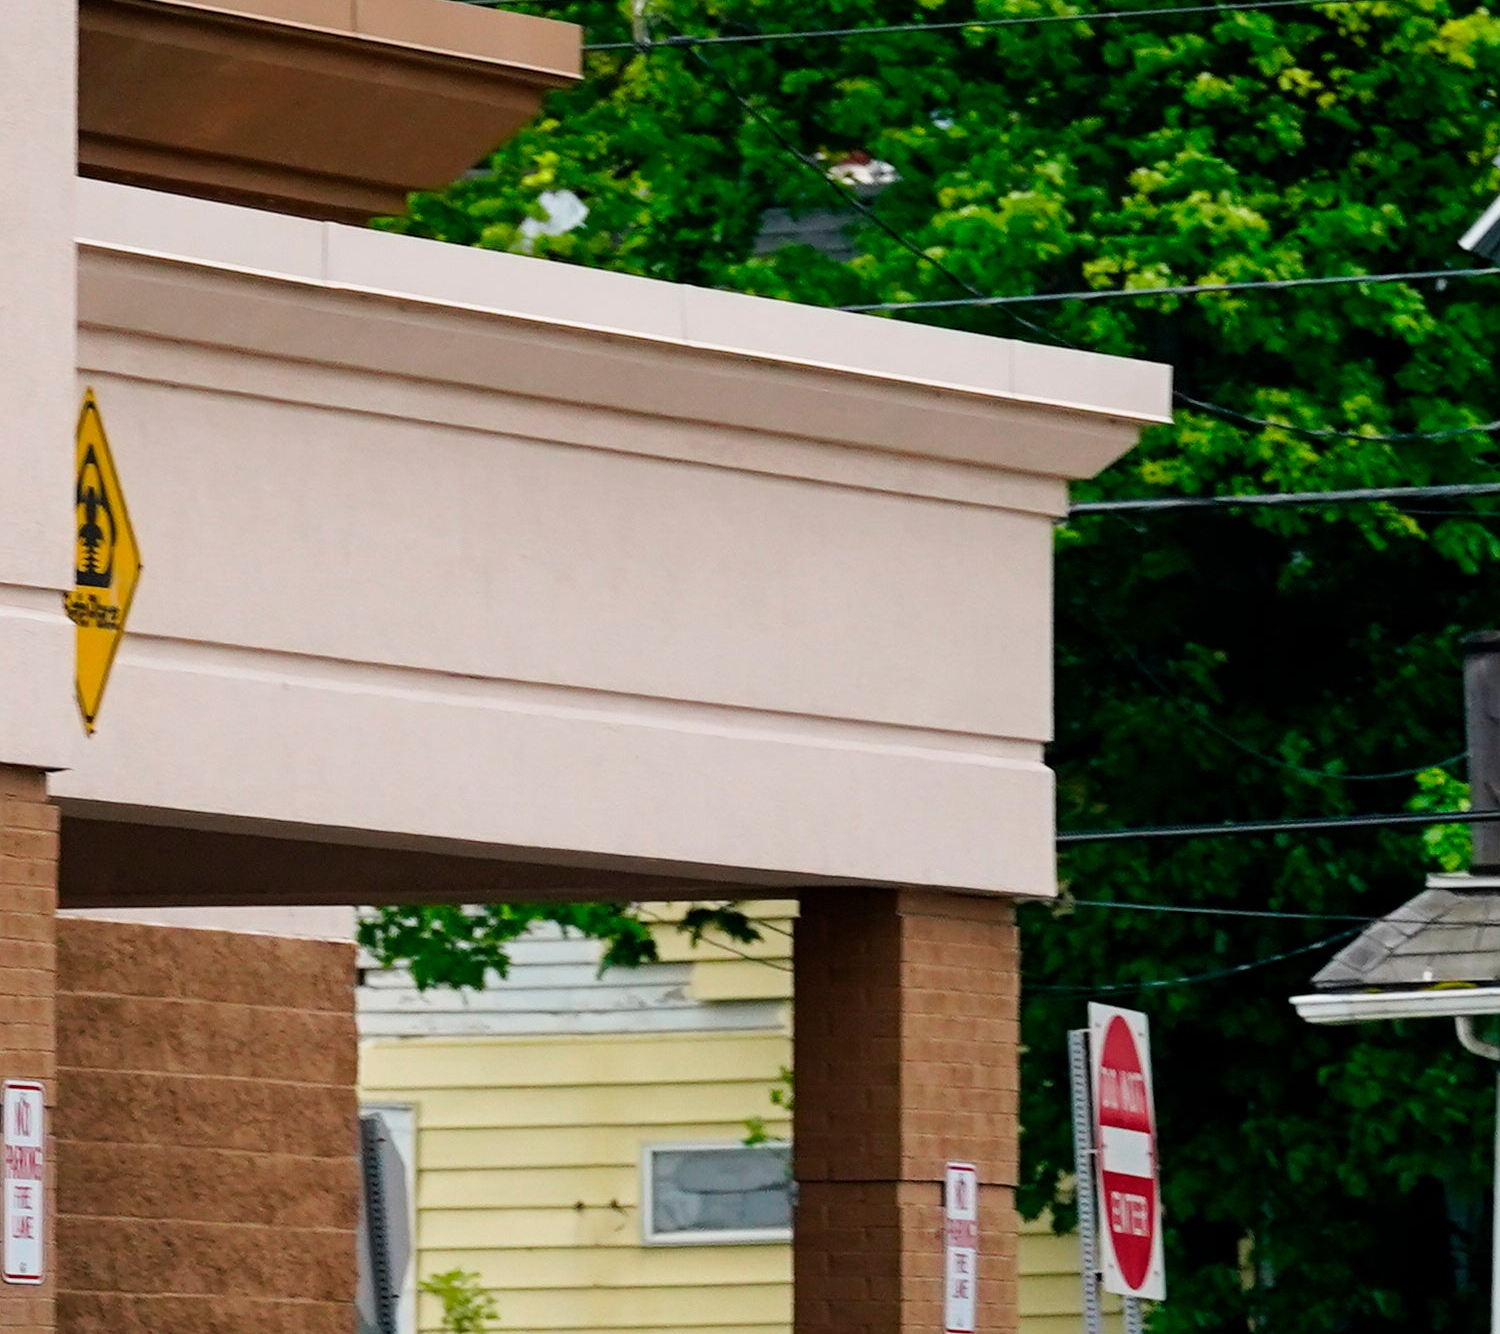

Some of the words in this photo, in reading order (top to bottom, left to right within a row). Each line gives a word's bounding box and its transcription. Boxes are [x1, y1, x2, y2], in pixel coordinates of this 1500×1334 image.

[1100, 1066, 1119, 1111] DO
[1119, 1070, 1146, 1115] NOT
[1110, 1191, 1149, 1238] ENTER
